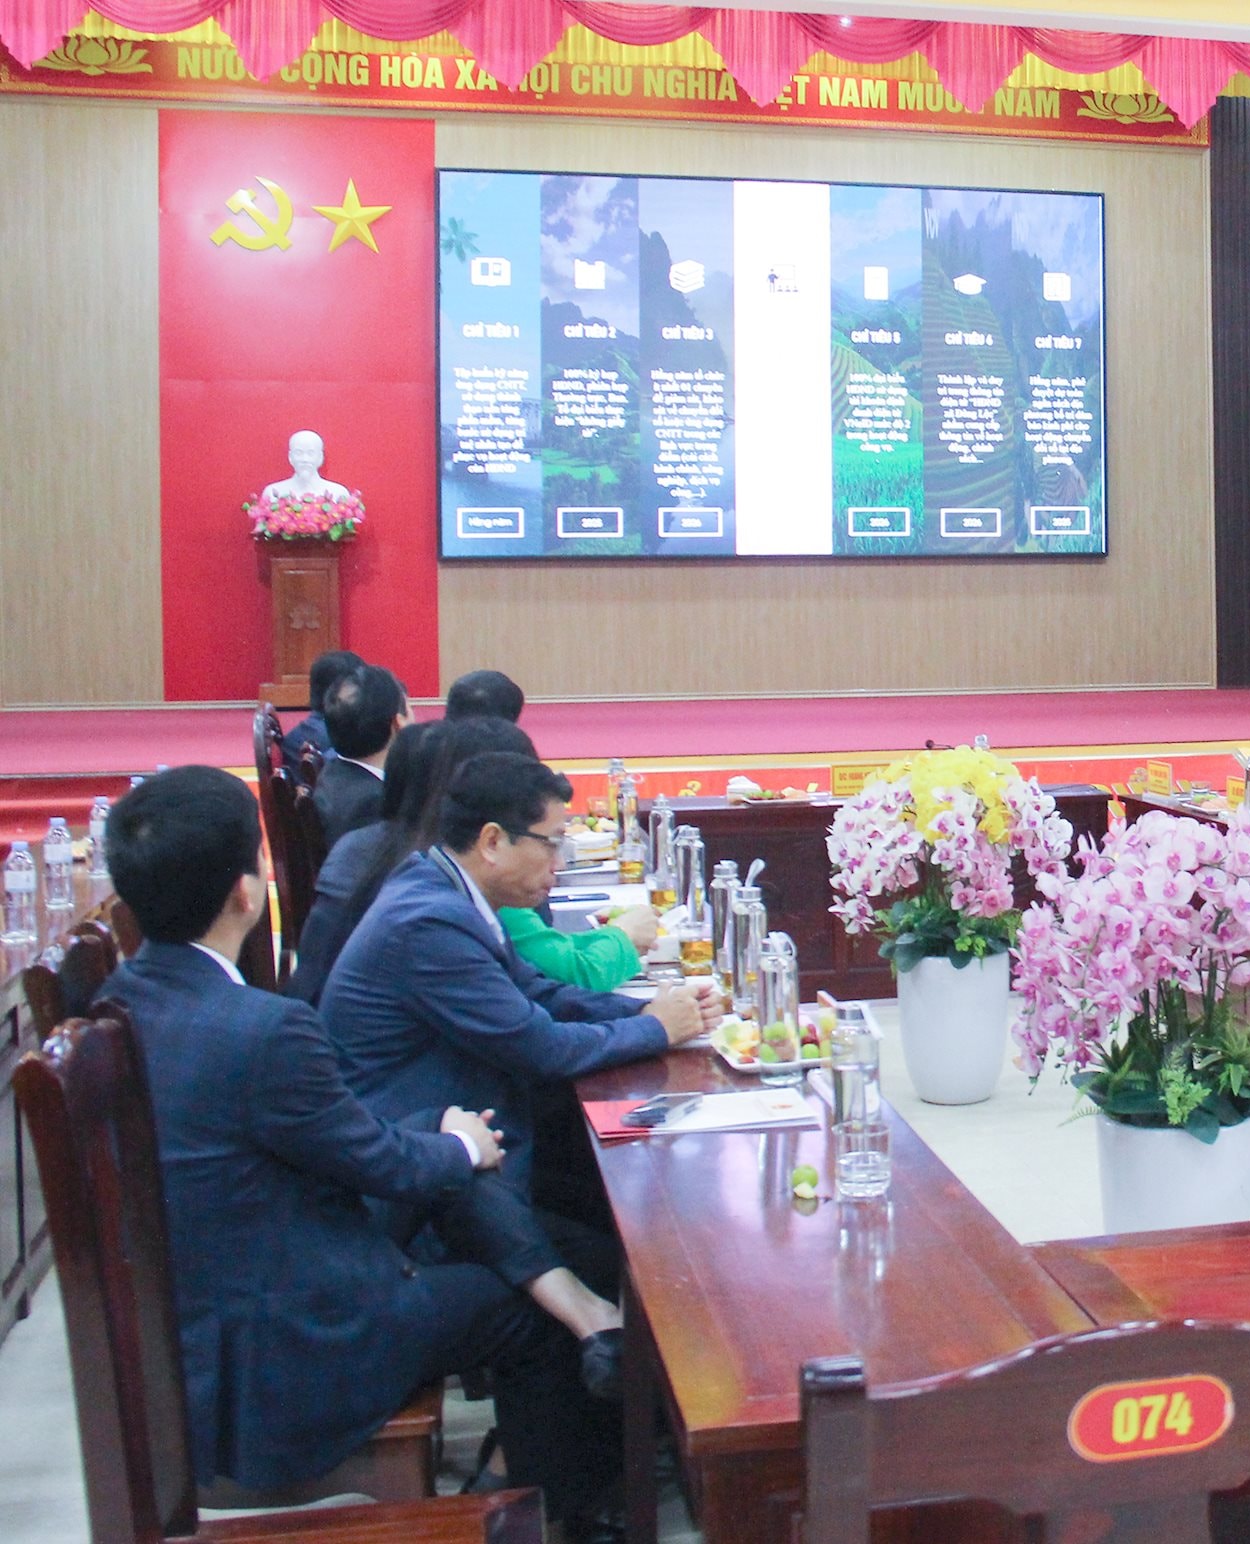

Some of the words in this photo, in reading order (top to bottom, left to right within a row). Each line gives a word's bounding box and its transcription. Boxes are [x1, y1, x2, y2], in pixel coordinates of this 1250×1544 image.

[380, 53, 445, 89] HÒA
[819, 76, 888, 109] NAM
[512, 324, 520, 338] 1
[608, 326, 617, 339] 2
[705, 328, 714, 341] 3
[893, 331, 901, 344] 5
[986, 334, 993, 346] 6
[1075, 337, 1082, 350] 7
[1112, 1391, 1193, 1444] 074
